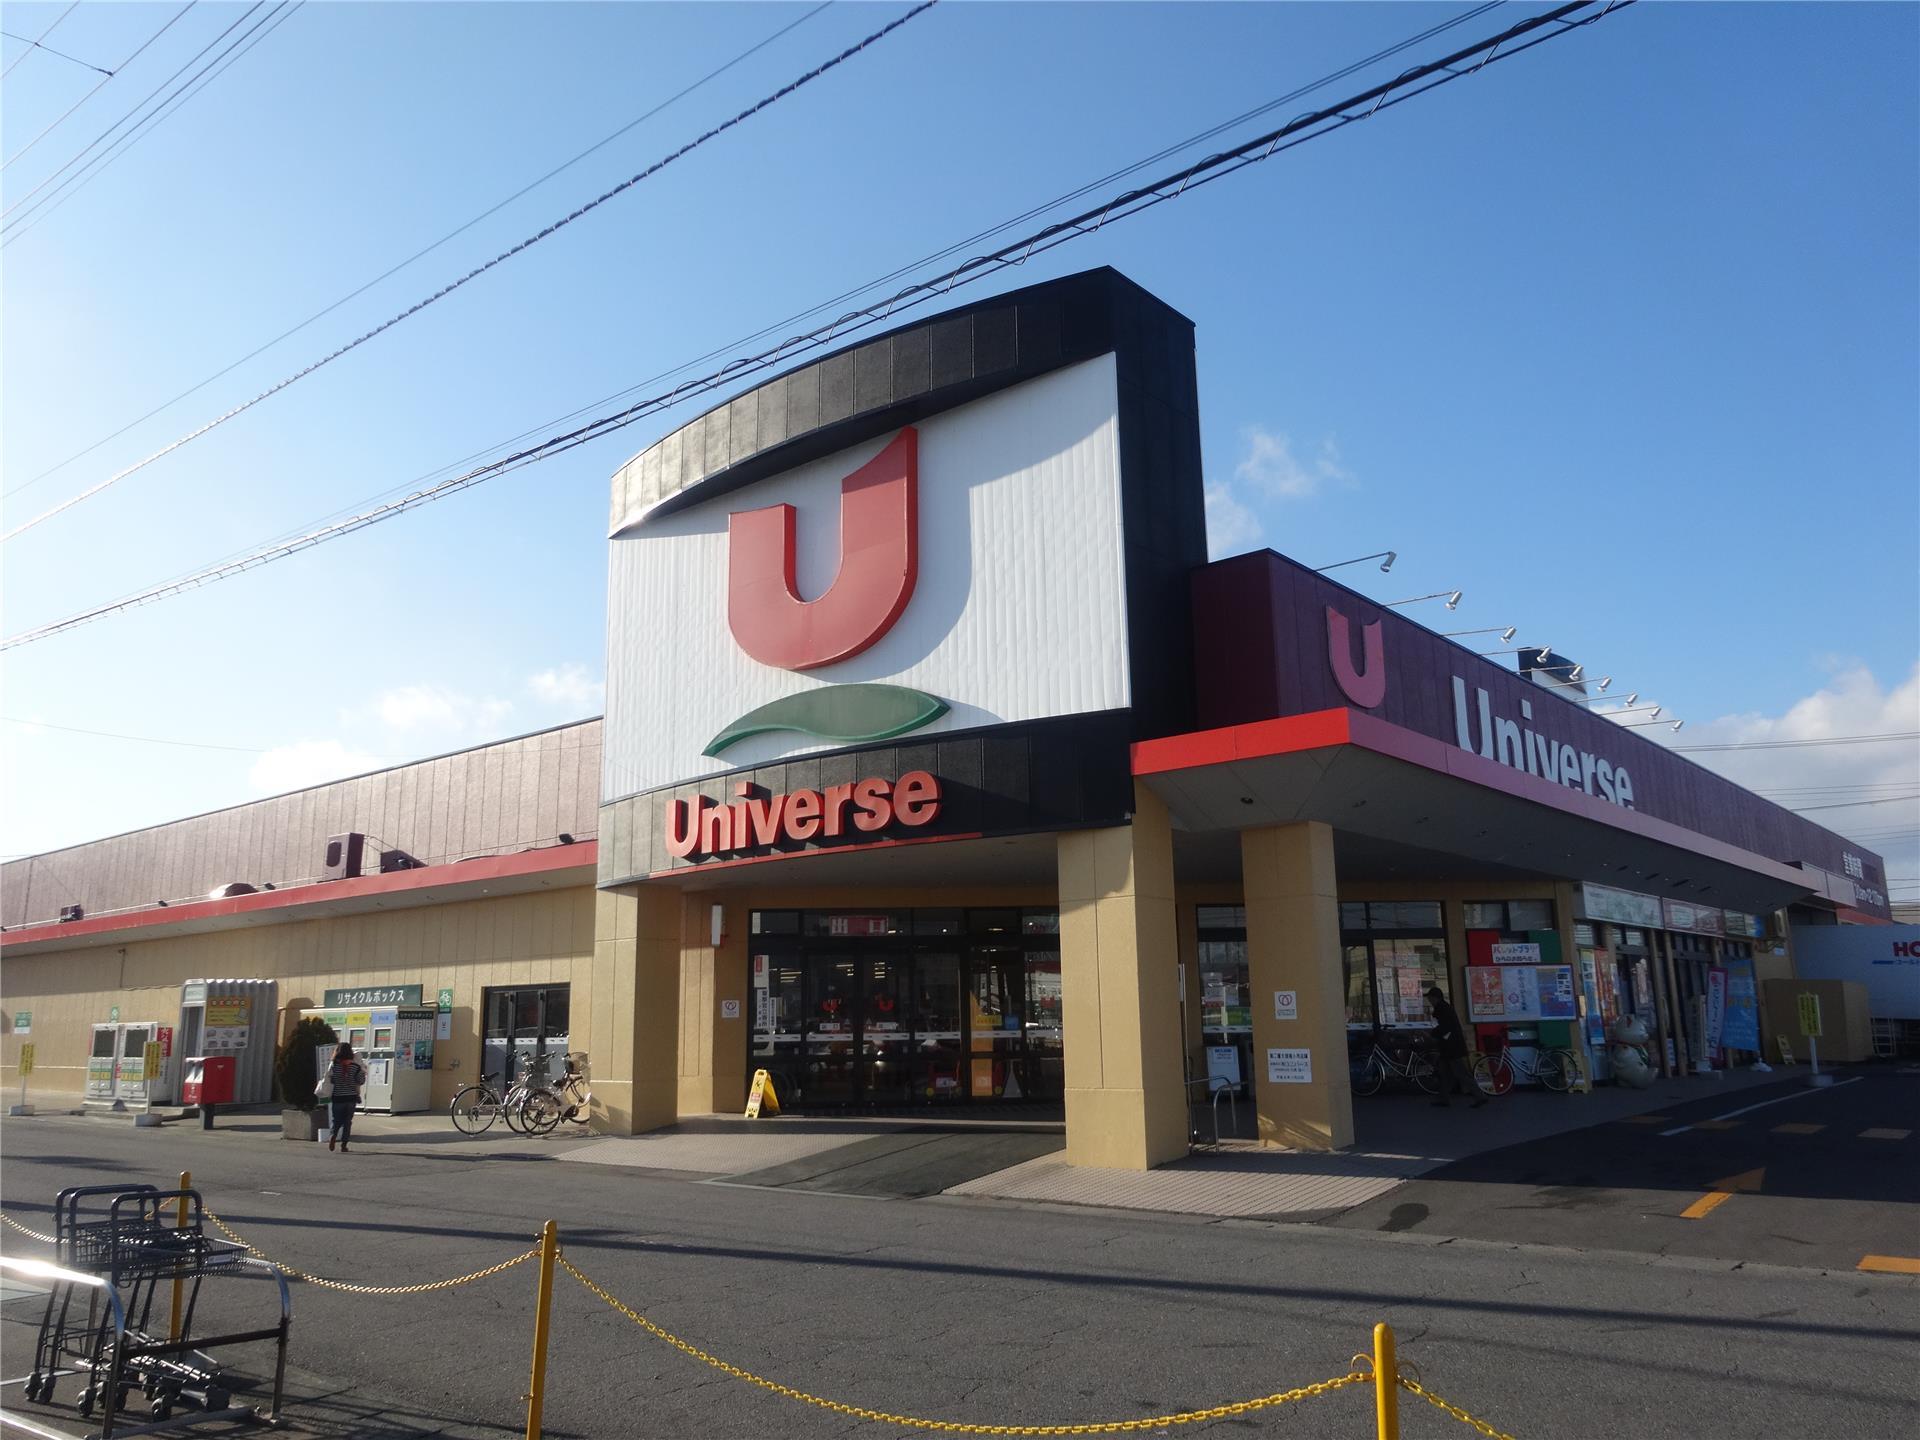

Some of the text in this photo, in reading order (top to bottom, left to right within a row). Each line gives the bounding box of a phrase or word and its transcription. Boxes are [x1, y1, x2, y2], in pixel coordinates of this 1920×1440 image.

[1452, 675, 1635, 810] Universe
[665, 769, 943, 863] Universe
[831, 917, 886, 934] 出口
[336, 989, 405, 1005] リサイクルボックス
